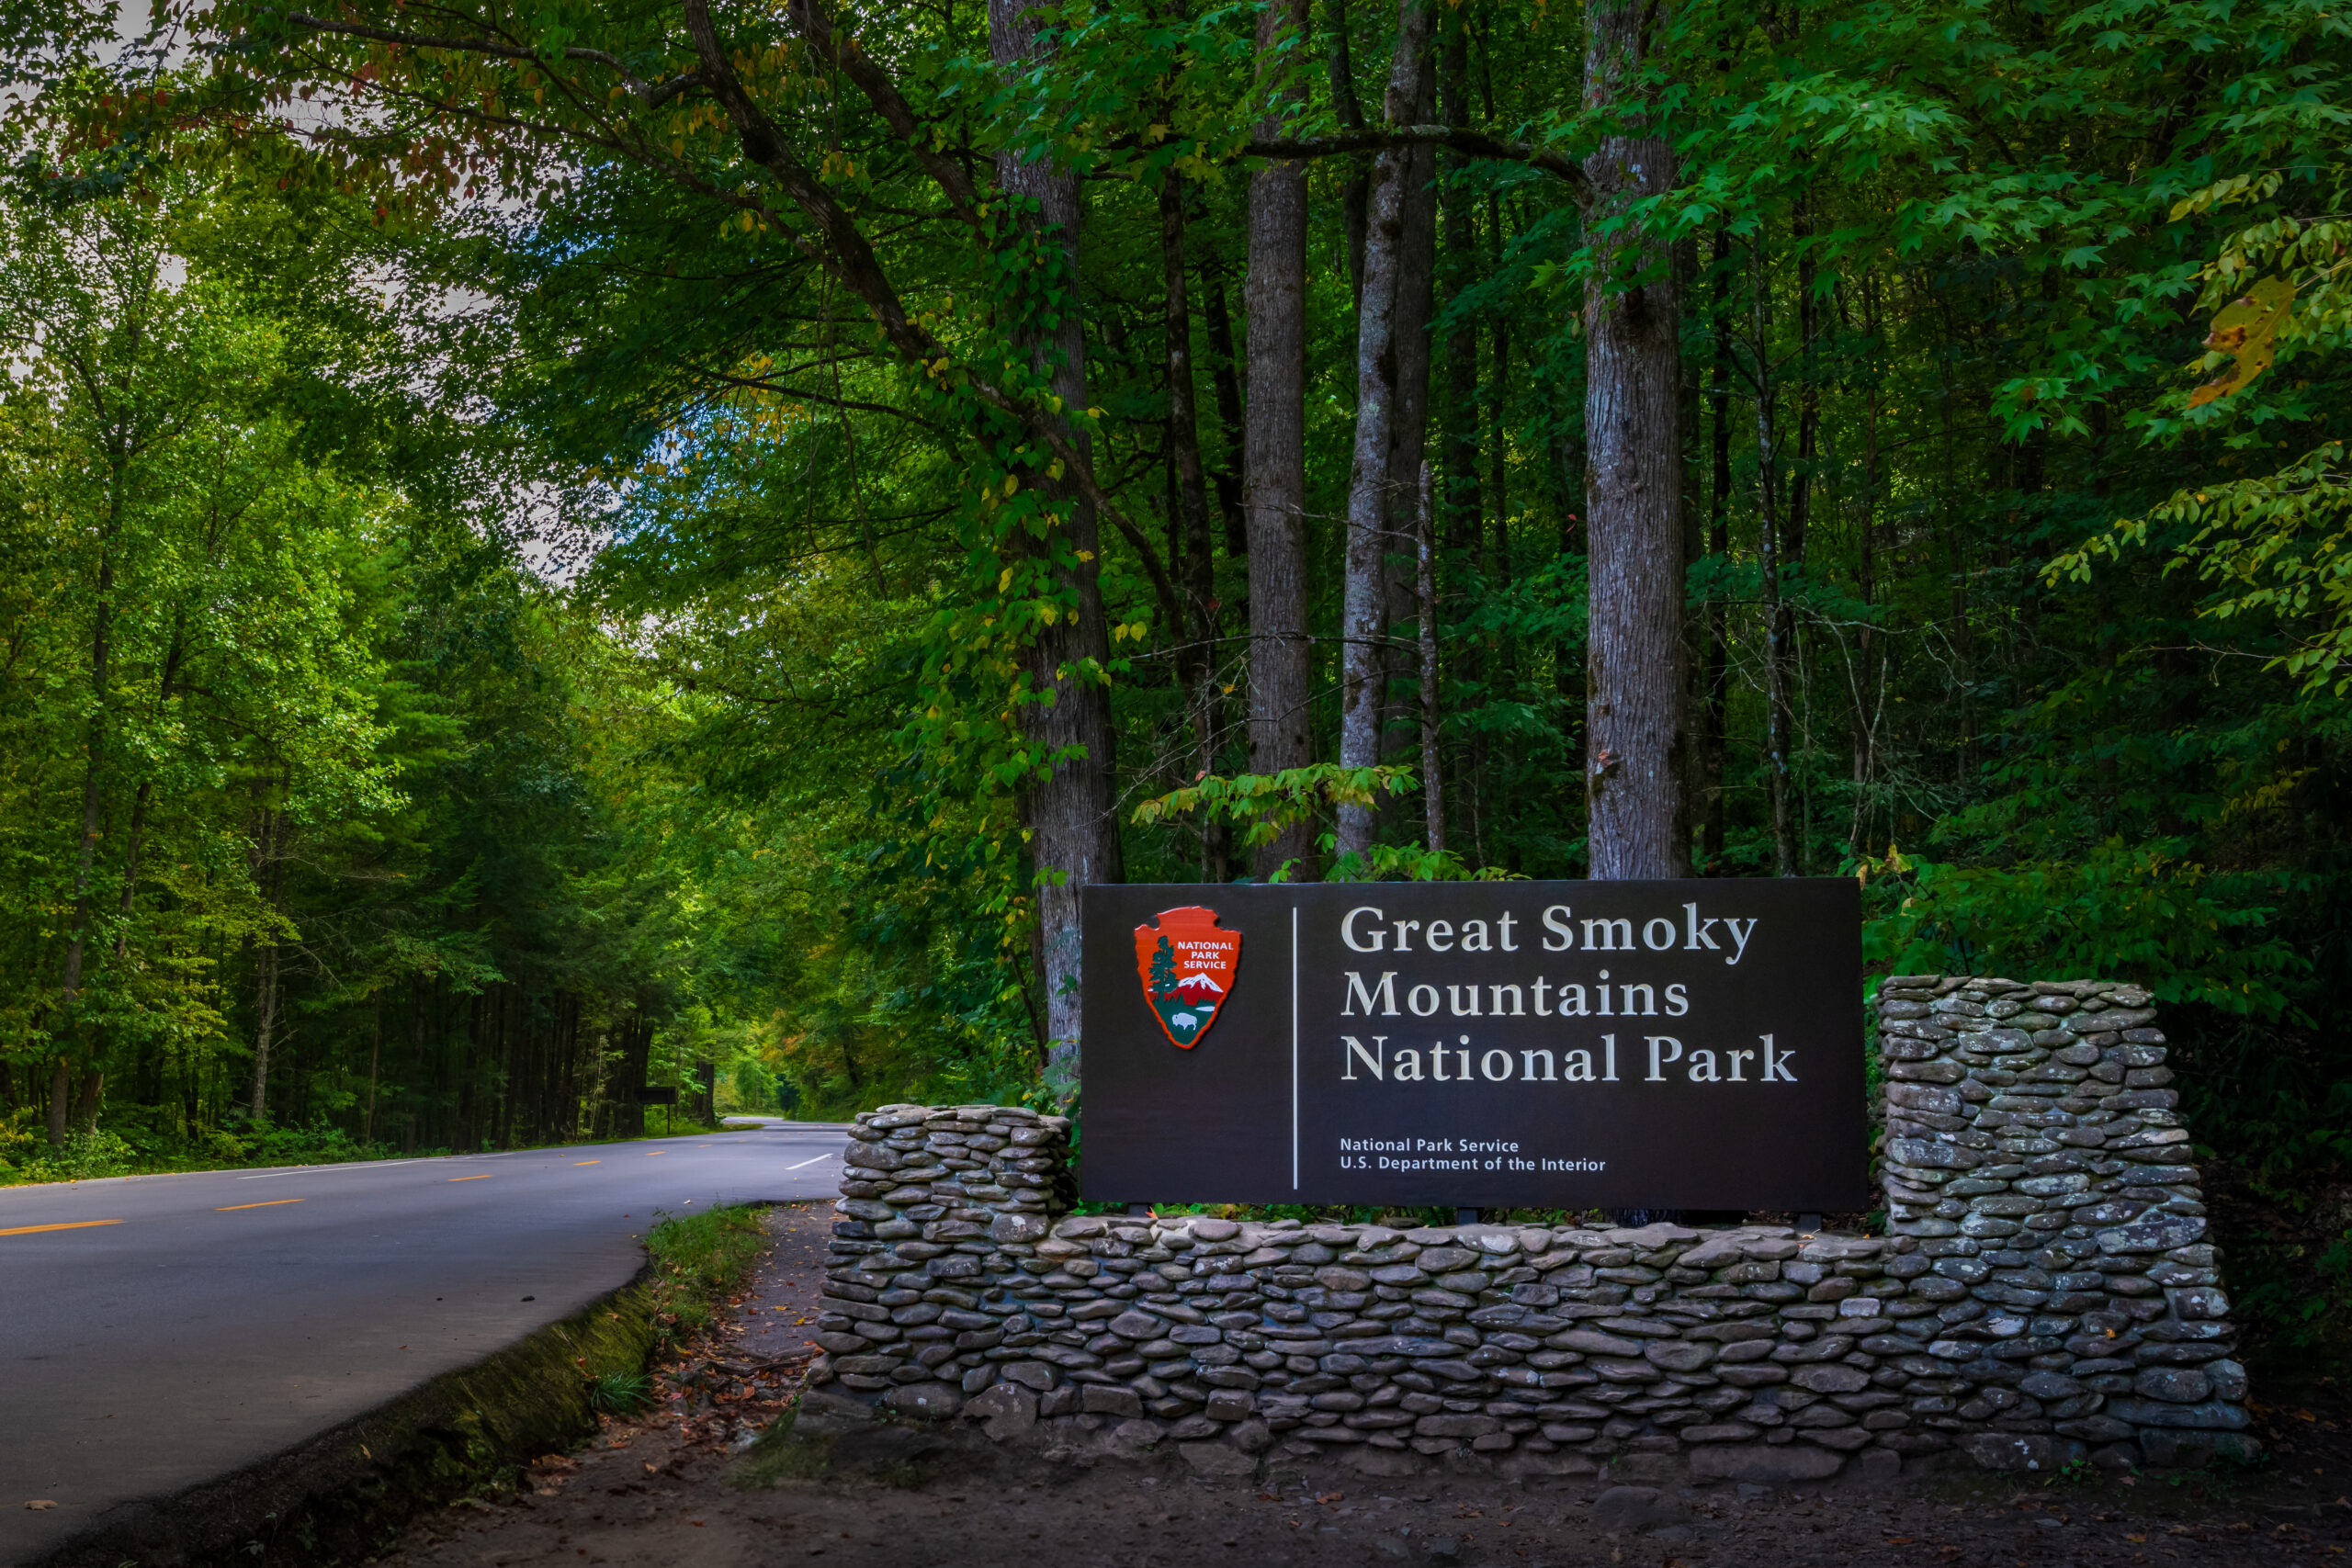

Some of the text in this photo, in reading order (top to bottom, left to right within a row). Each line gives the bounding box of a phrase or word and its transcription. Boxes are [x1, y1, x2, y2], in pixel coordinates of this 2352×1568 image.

[1340, 902, 1758, 965] Great Smoky
[1178, 941, 1234, 950] NATIONAL
[1191, 951, 1220, 960] PARK
[1183, 960, 1227, 969] SERVICE
[1340, 969, 1689, 1017] Mountains
[1340, 1033, 1798, 1082] National Park
[1340, 1137, 1520, 1153] National Park Service
[1340, 1156, 1606, 1173] U.S. Department of the Interior
